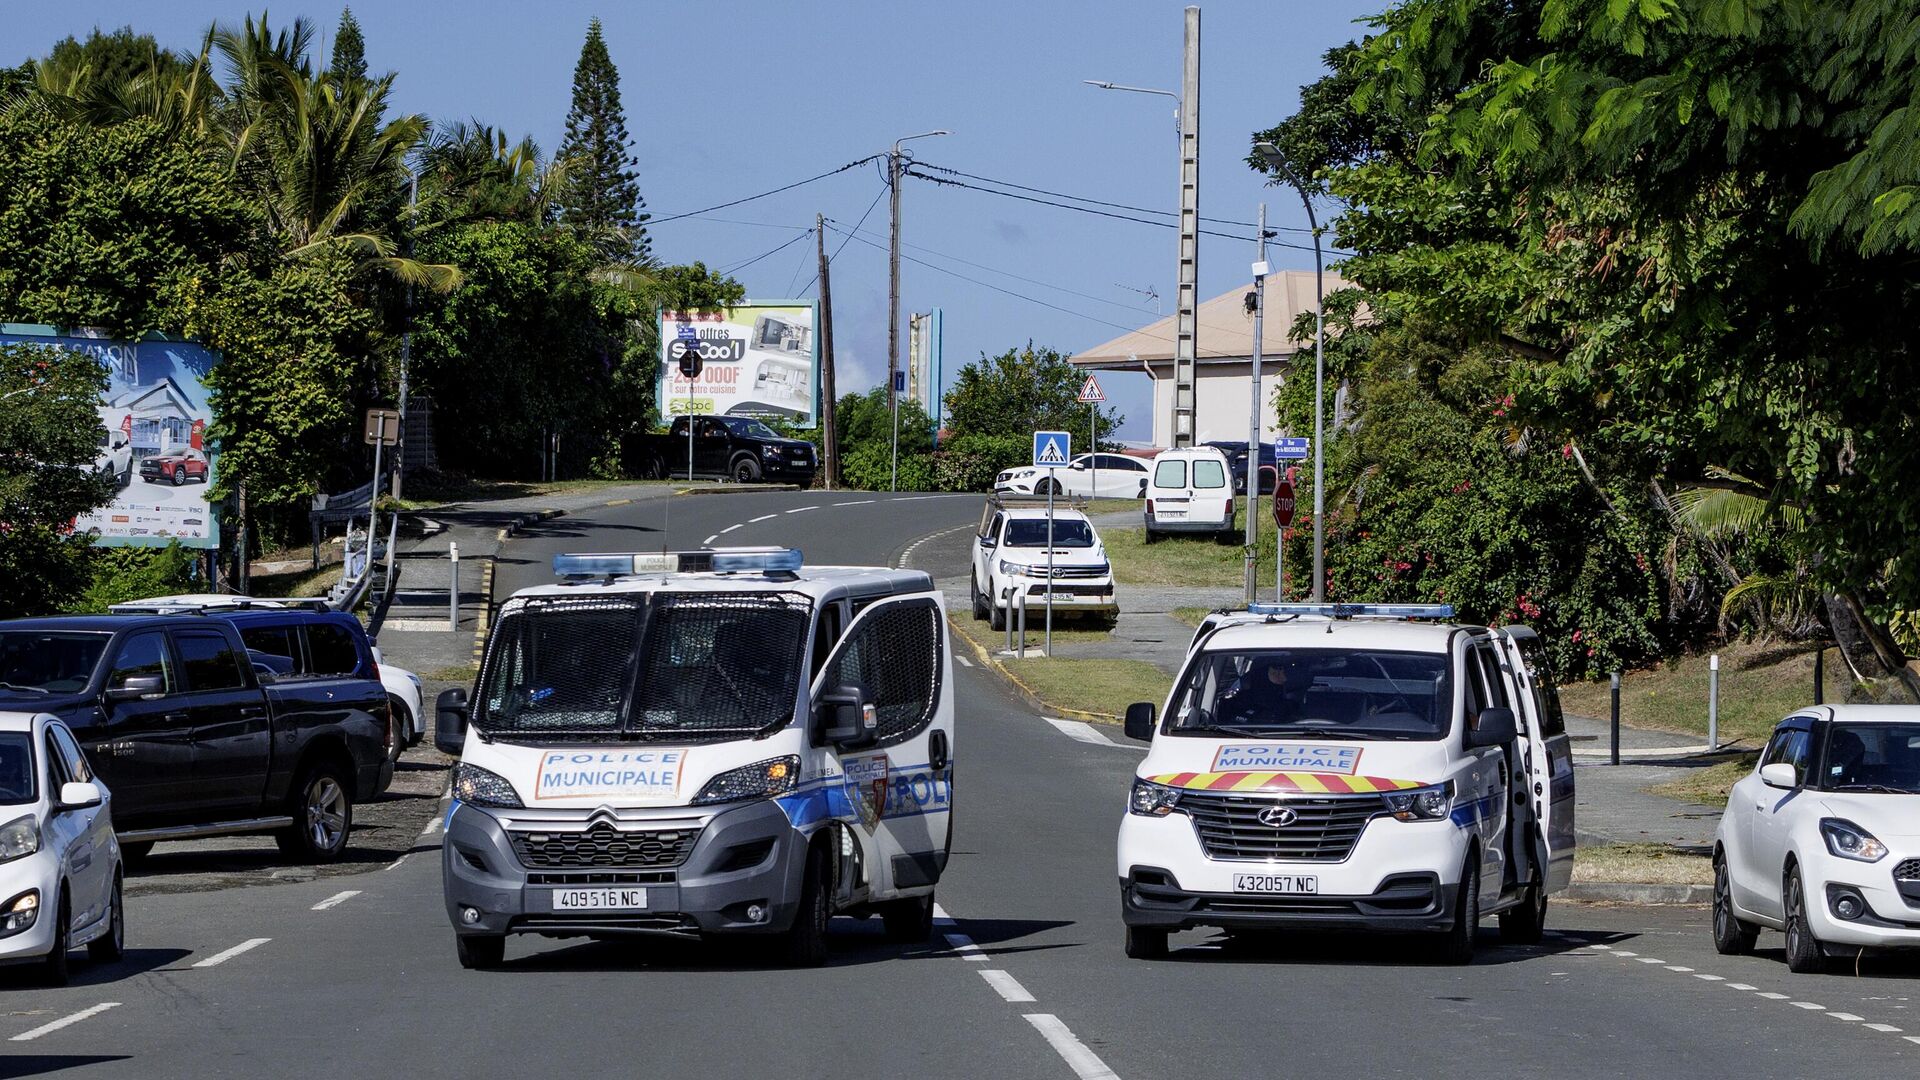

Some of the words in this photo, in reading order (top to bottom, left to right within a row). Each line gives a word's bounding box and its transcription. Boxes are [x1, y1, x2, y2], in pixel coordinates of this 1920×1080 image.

[700, 328, 729, 339] offres
[1276, 497, 1294, 511] STOP
[547, 753, 679, 765] POLICE
[1223, 747, 1356, 758] POLICE
[847, 761, 885, 775] POLICE
[1219, 757, 1351, 769] MUNICIPALE
[543, 771, 674, 788] MUNICIPALE
[1237, 875, 1292, 892] 432057
[1296, 877, 1314, 892] NC
[561, 891, 617, 907] 409516
[621, 891, 639, 906] NC
